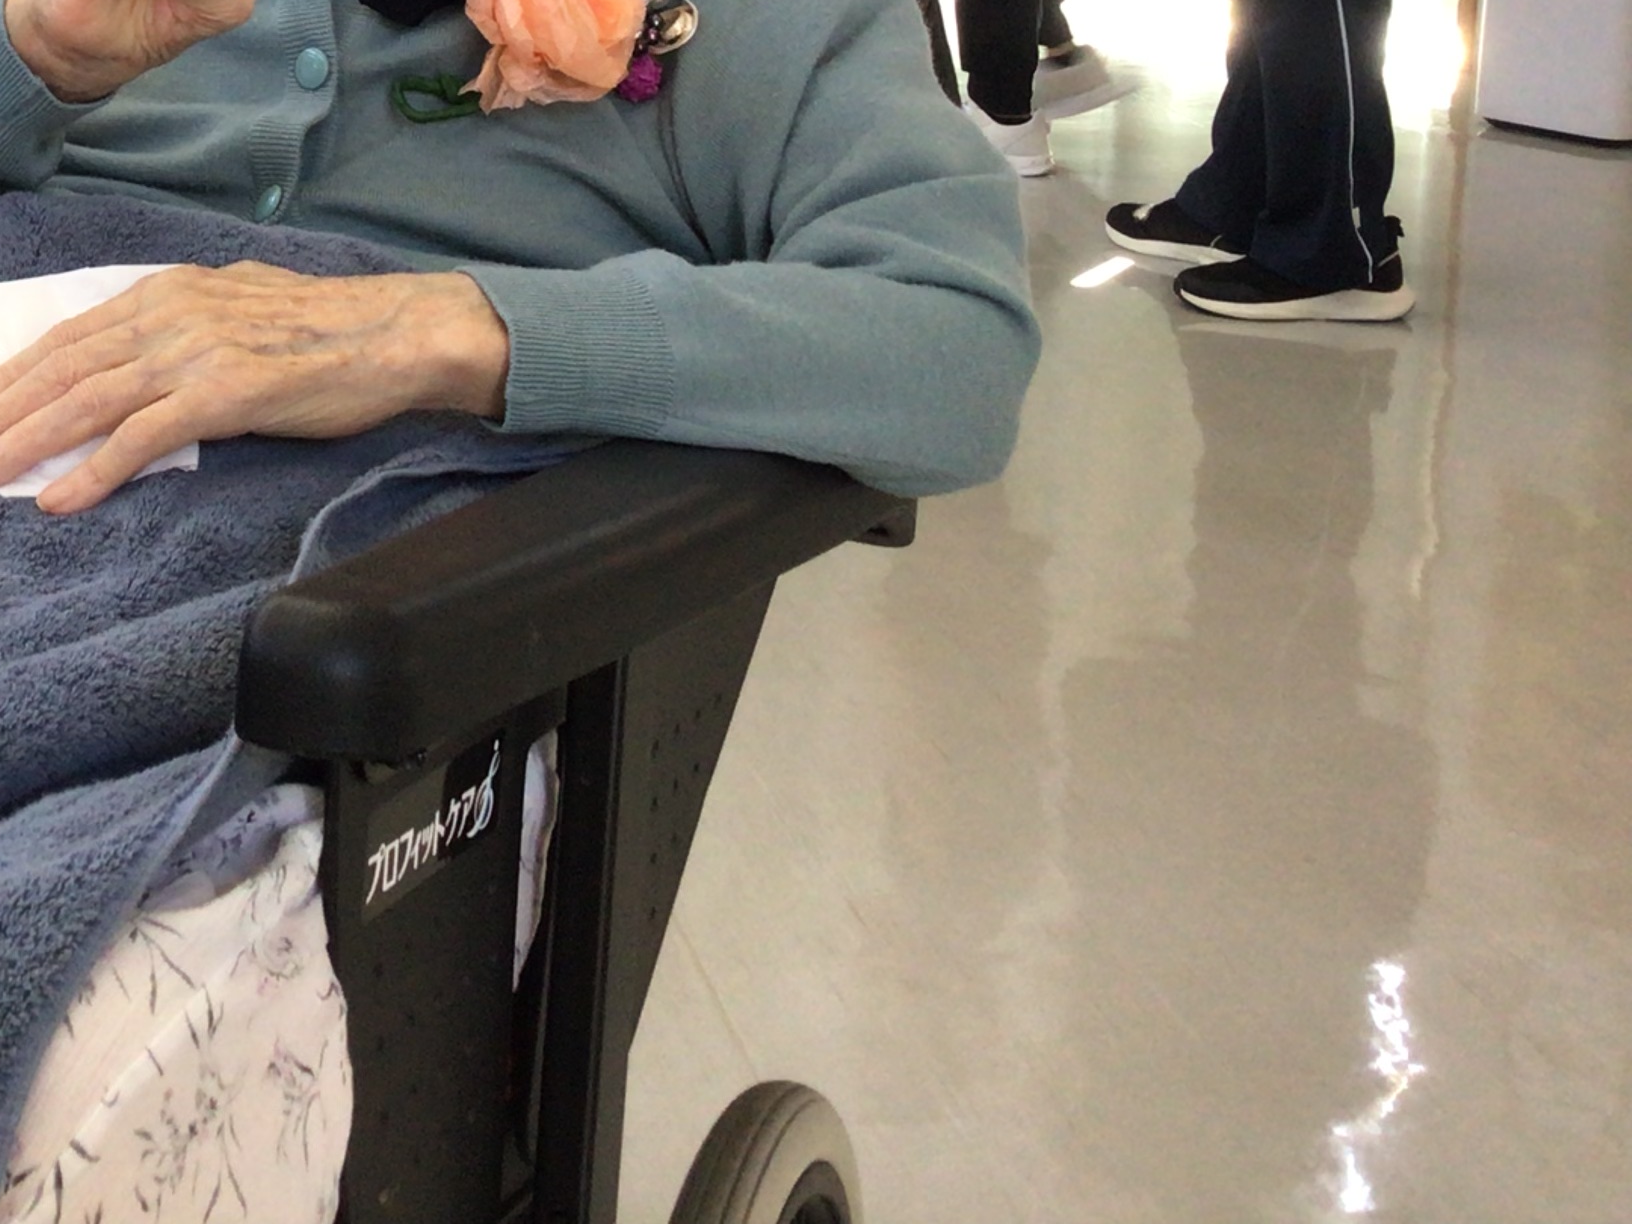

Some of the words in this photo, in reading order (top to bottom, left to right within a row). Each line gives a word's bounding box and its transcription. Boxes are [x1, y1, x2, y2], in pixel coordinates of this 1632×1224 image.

[365, 785, 477, 905] プロフィットケア
